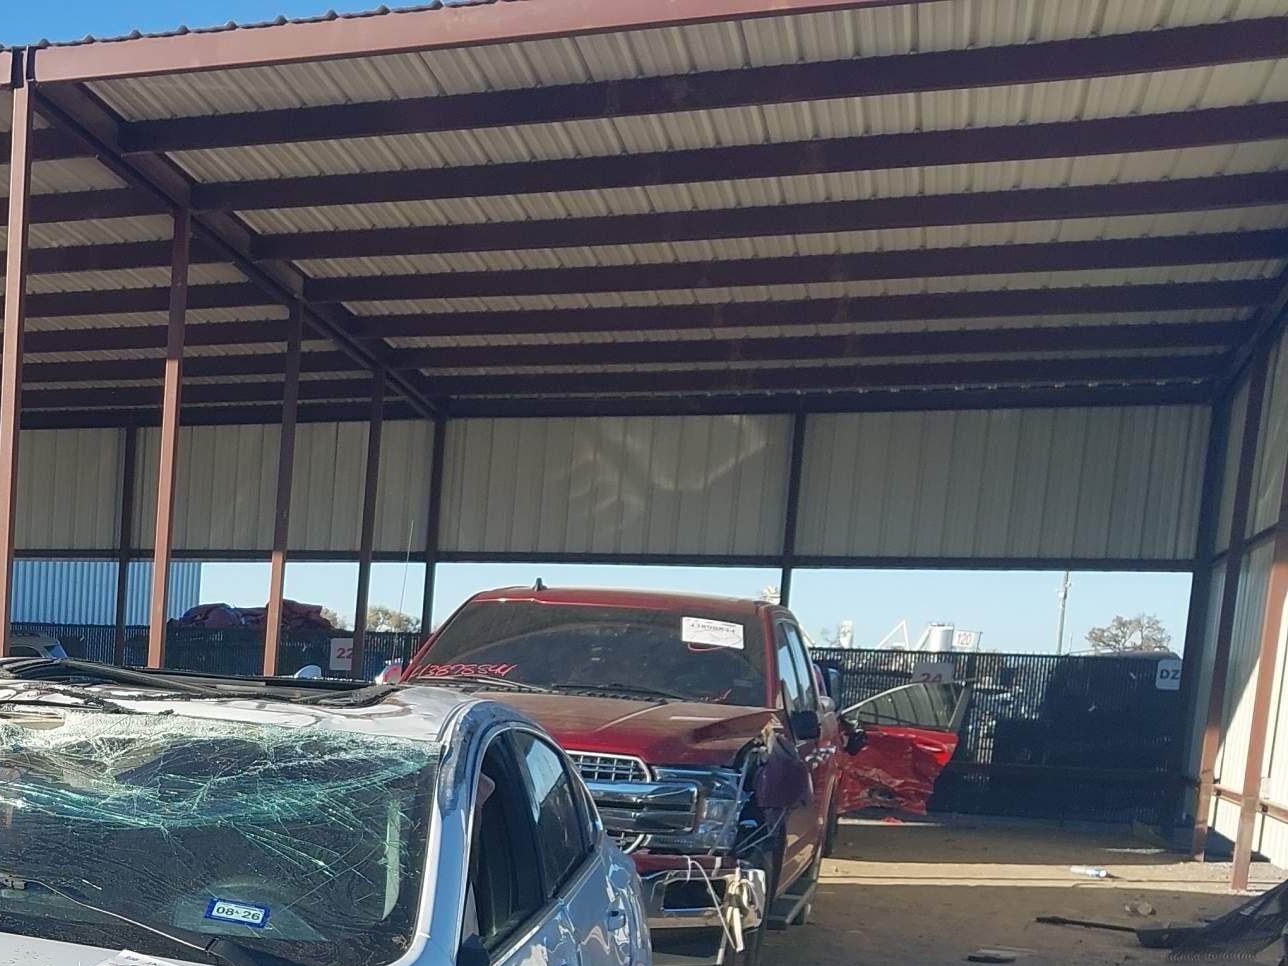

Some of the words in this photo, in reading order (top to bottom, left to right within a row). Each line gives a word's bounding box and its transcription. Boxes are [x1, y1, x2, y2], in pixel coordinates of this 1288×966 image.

[336, 647, 353, 659] 22
[215, 906, 235, 916] 08
[240, 910, 261, 921] 26
